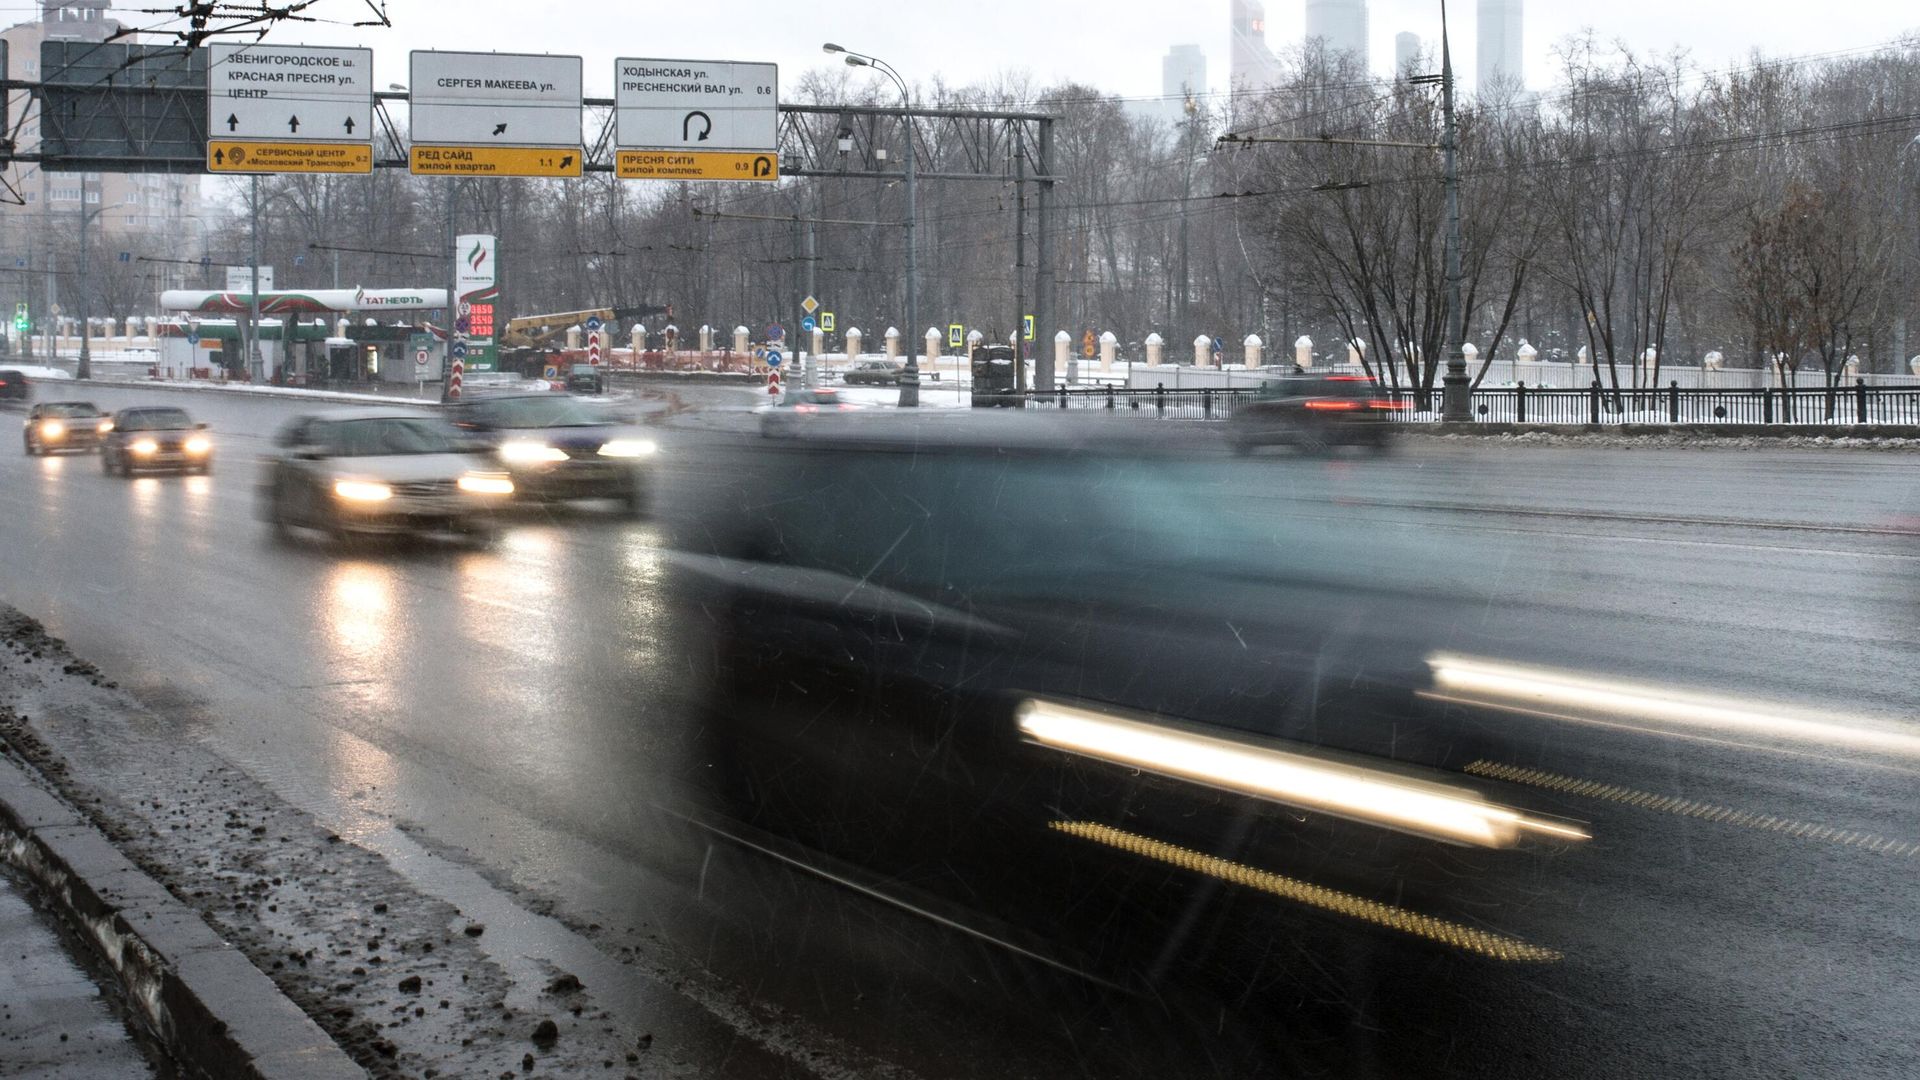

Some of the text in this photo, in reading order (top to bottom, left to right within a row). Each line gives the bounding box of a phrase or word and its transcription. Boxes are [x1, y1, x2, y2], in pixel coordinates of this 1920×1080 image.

[228, 54, 339, 67] ЗВЕНИГОРОДСКОЕ
[228, 71, 355, 86] КРАСНАЯ ПРЕСНЯ ул.
[623, 67, 708, 80] ХОДЫНСКАЯ ул.
[437, 78, 556, 92] СЕРГЕЯ МАКЕЕВА ул.
[623, 82, 743, 96] ПРЕСНЕНСКИЙ ВАЛ ул.
[228, 88, 268, 99] ЦЕНТР
[756, 86, 771, 95] 0.6
[256, 149, 346, 158] СЕРВИСНЫЙ ЦЕНТР
[418, 149, 473, 161] РЕД САЙД
[246, 157, 355, 168] «Московский Транспорт»
[539, 158, 553, 167] 1.1
[623, 155, 694, 165] ПРЕСНЯ СИТИ
[418, 162, 496, 172] жилой квартал
[622, 165, 703, 175] жилой комплекс
[735, 162, 749, 171] 0.9
[365, 296, 424, 305] ТАТНЕФТЬ
